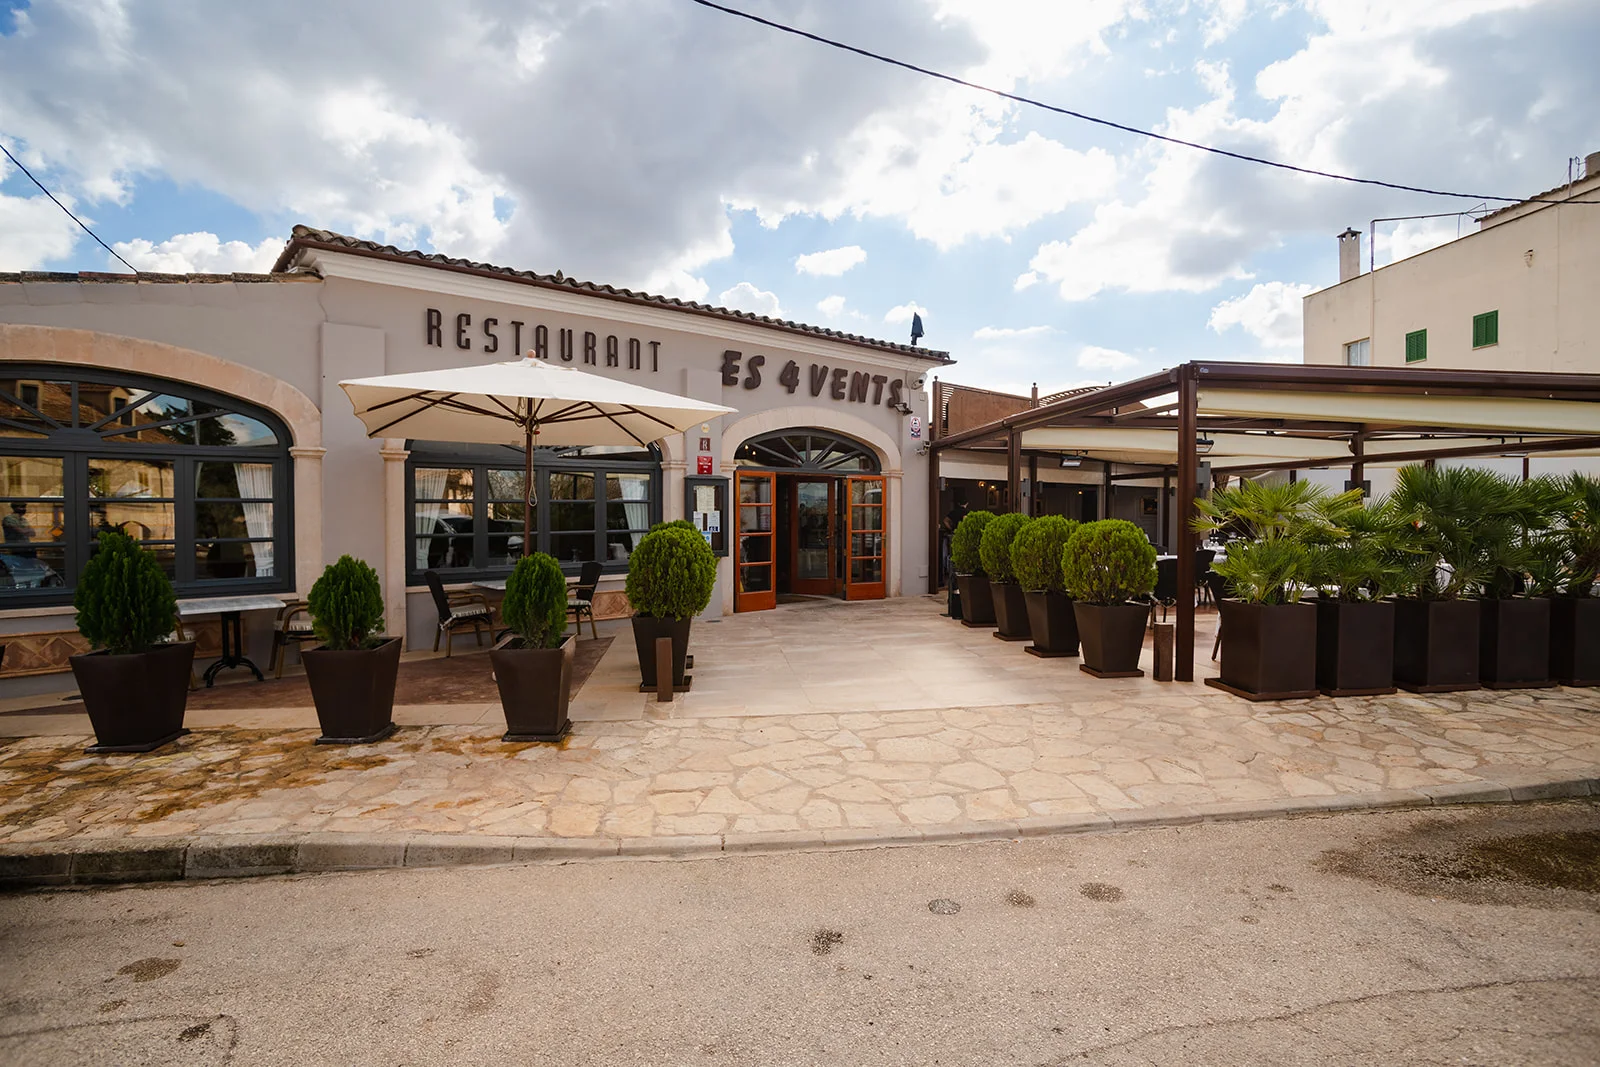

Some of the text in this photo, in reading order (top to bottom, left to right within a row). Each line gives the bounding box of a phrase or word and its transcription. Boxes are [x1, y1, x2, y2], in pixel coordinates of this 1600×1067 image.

[427, 308, 904, 408] RESTAURANT ES 4 VENTS
